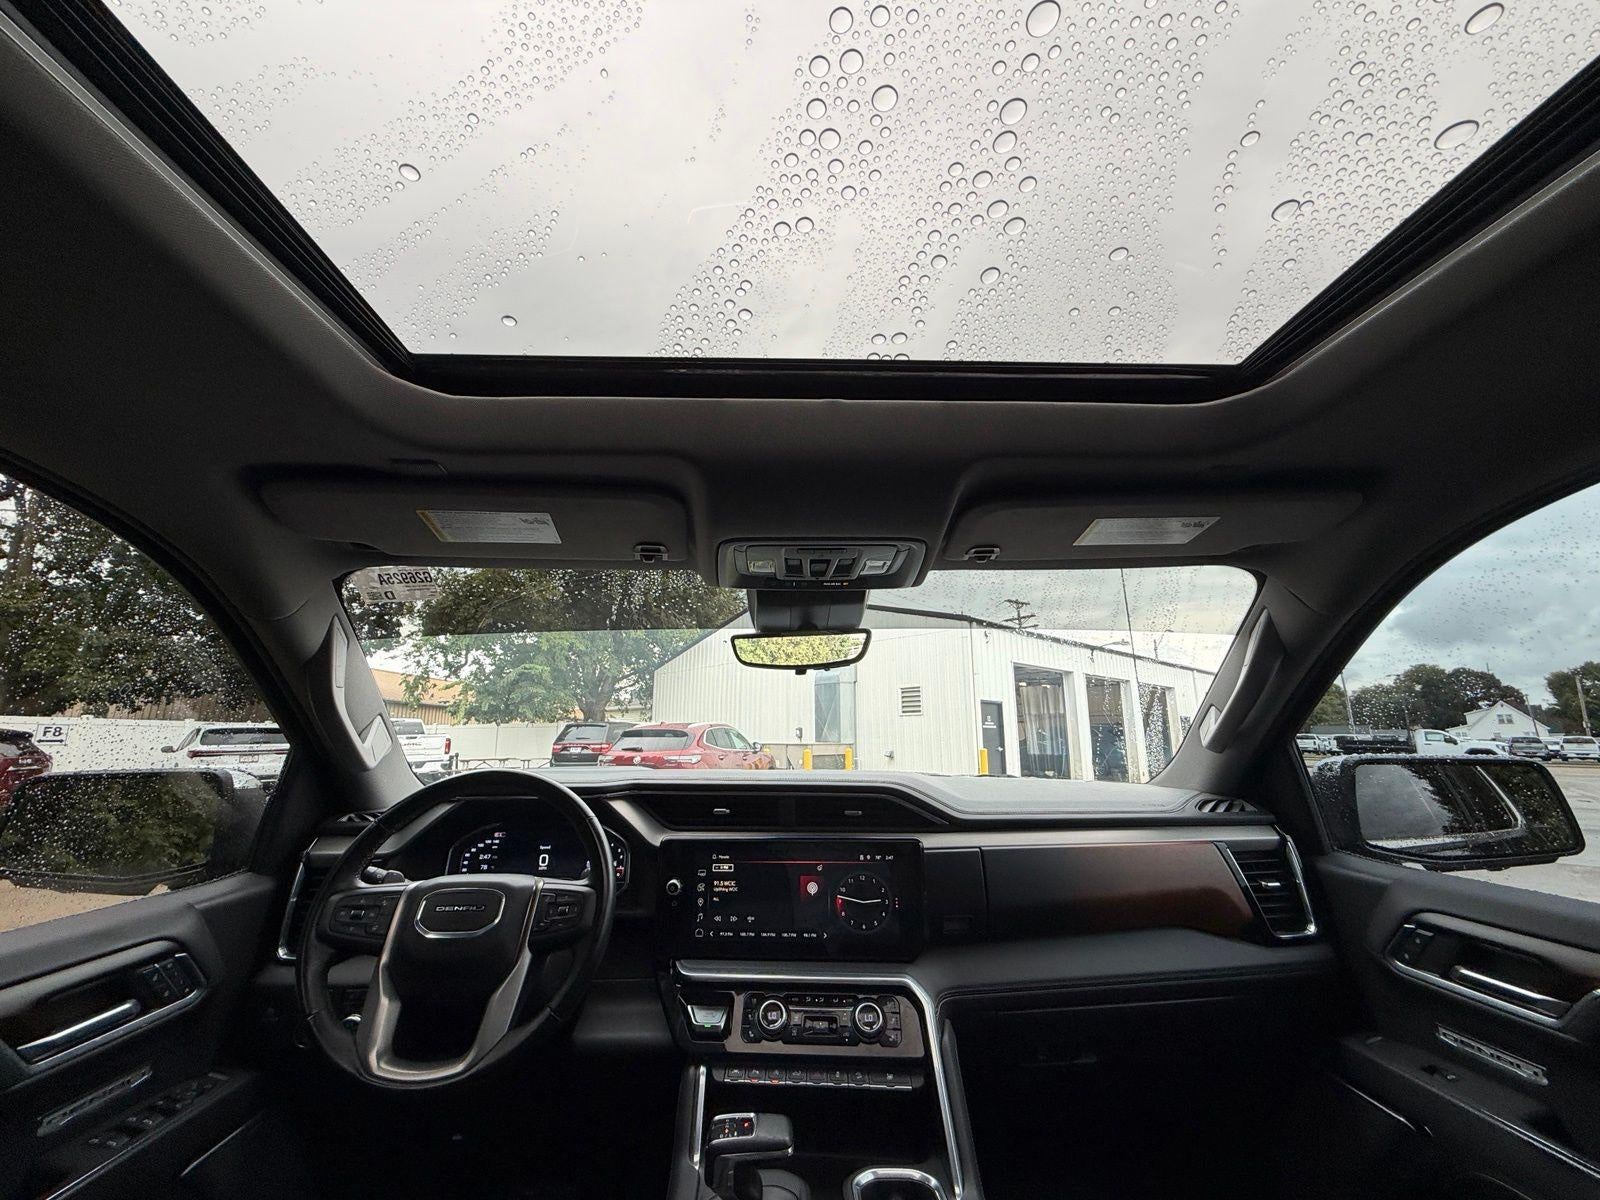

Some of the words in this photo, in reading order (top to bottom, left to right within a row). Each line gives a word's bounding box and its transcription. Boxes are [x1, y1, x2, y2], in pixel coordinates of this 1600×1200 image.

[42, 726, 62, 737] F8
[538, 854, 549, 866] 0
[864, 1013, 873, 1022] LO
